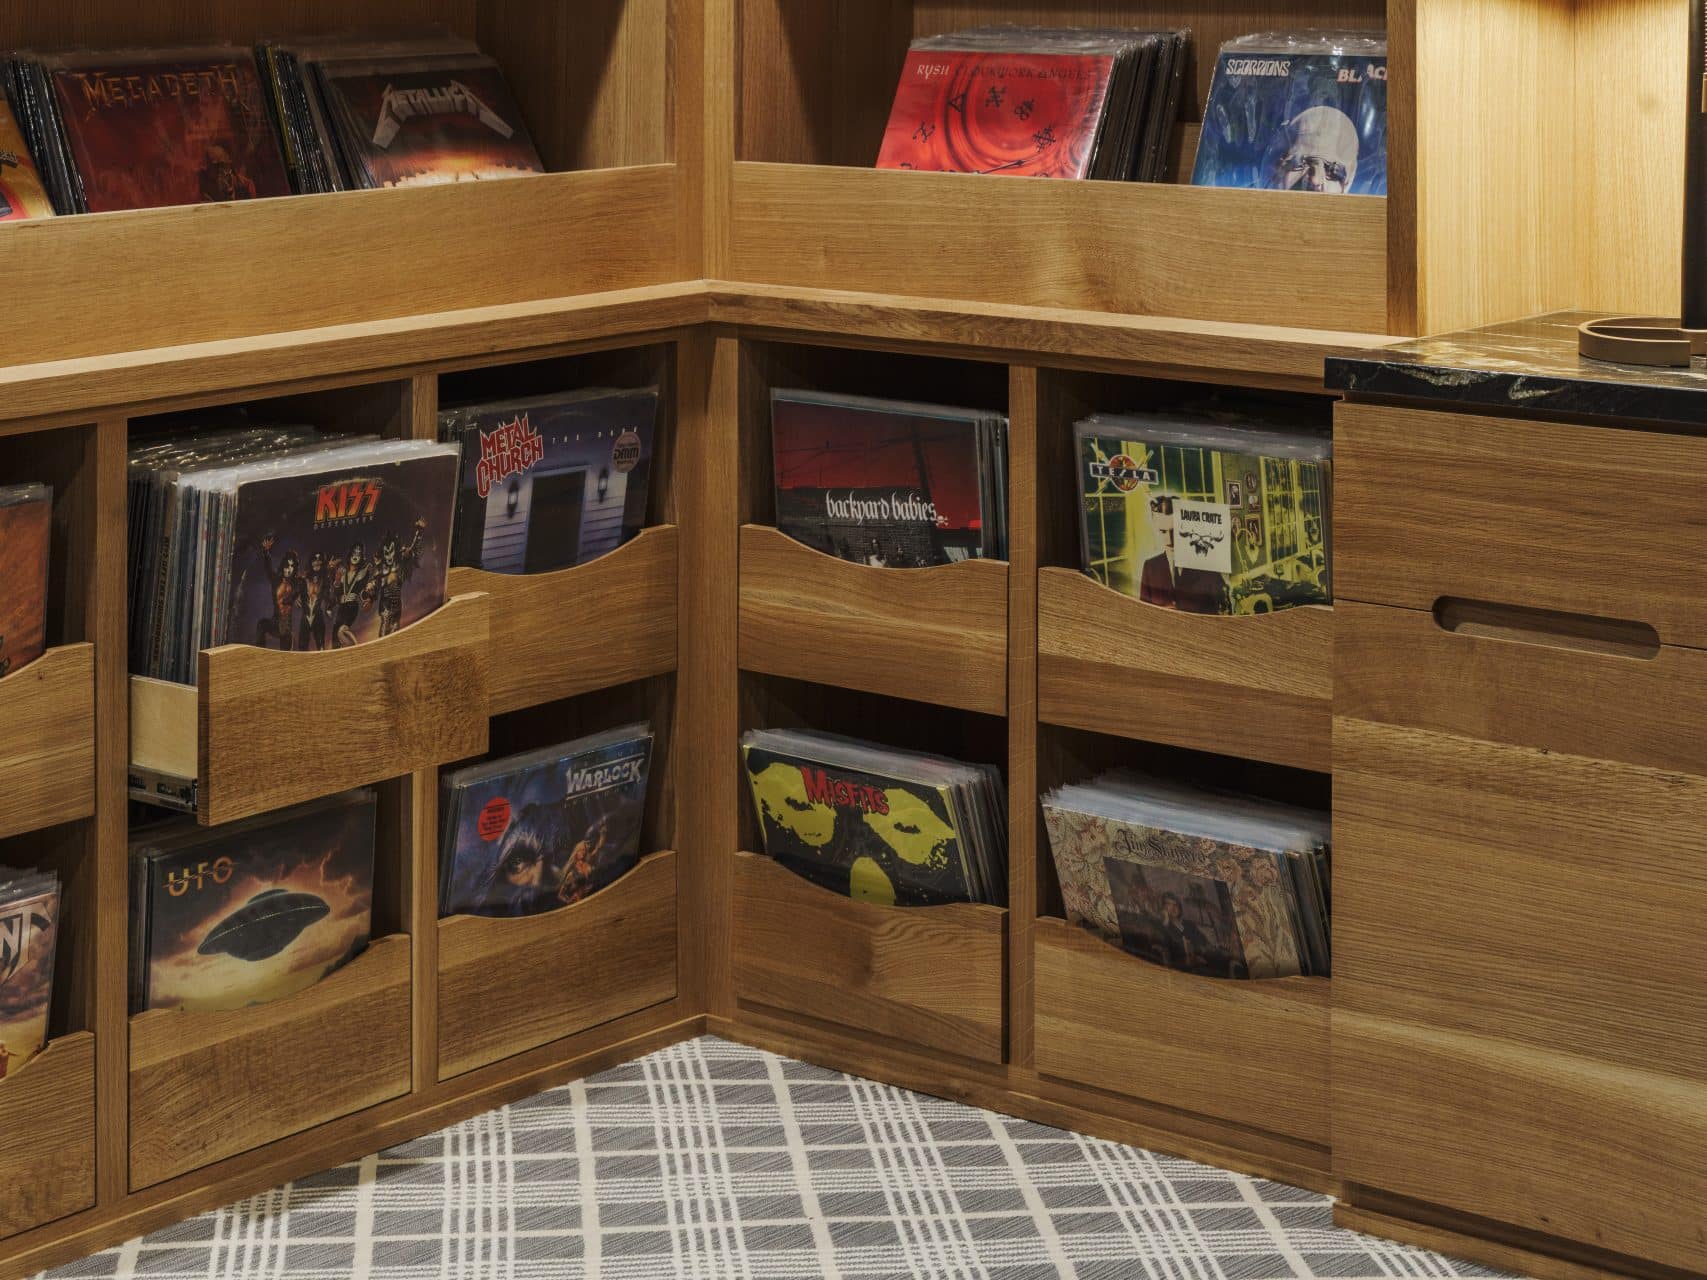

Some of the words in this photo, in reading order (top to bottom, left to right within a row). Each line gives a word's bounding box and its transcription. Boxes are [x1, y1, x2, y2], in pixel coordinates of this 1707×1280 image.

[74, 65, 239, 110] MEGADETH
[916, 64, 950, 81] RUSH
[1225, 59, 1291, 77] SCORPIONS
[373, 80, 514, 149] METALLICA
[480, 413, 538, 461] METAL
[476, 435, 544, 499] CHURCH
[1096, 466, 1151, 481] TESLA
[315, 480, 382, 523] KISS
[826, 490, 890, 526] backyard
[891, 491, 937, 521] babies
[566, 759, 646, 794] WARLOCK
[801, 767, 889, 816] MISFITS
[165, 855, 236, 898] UFO
